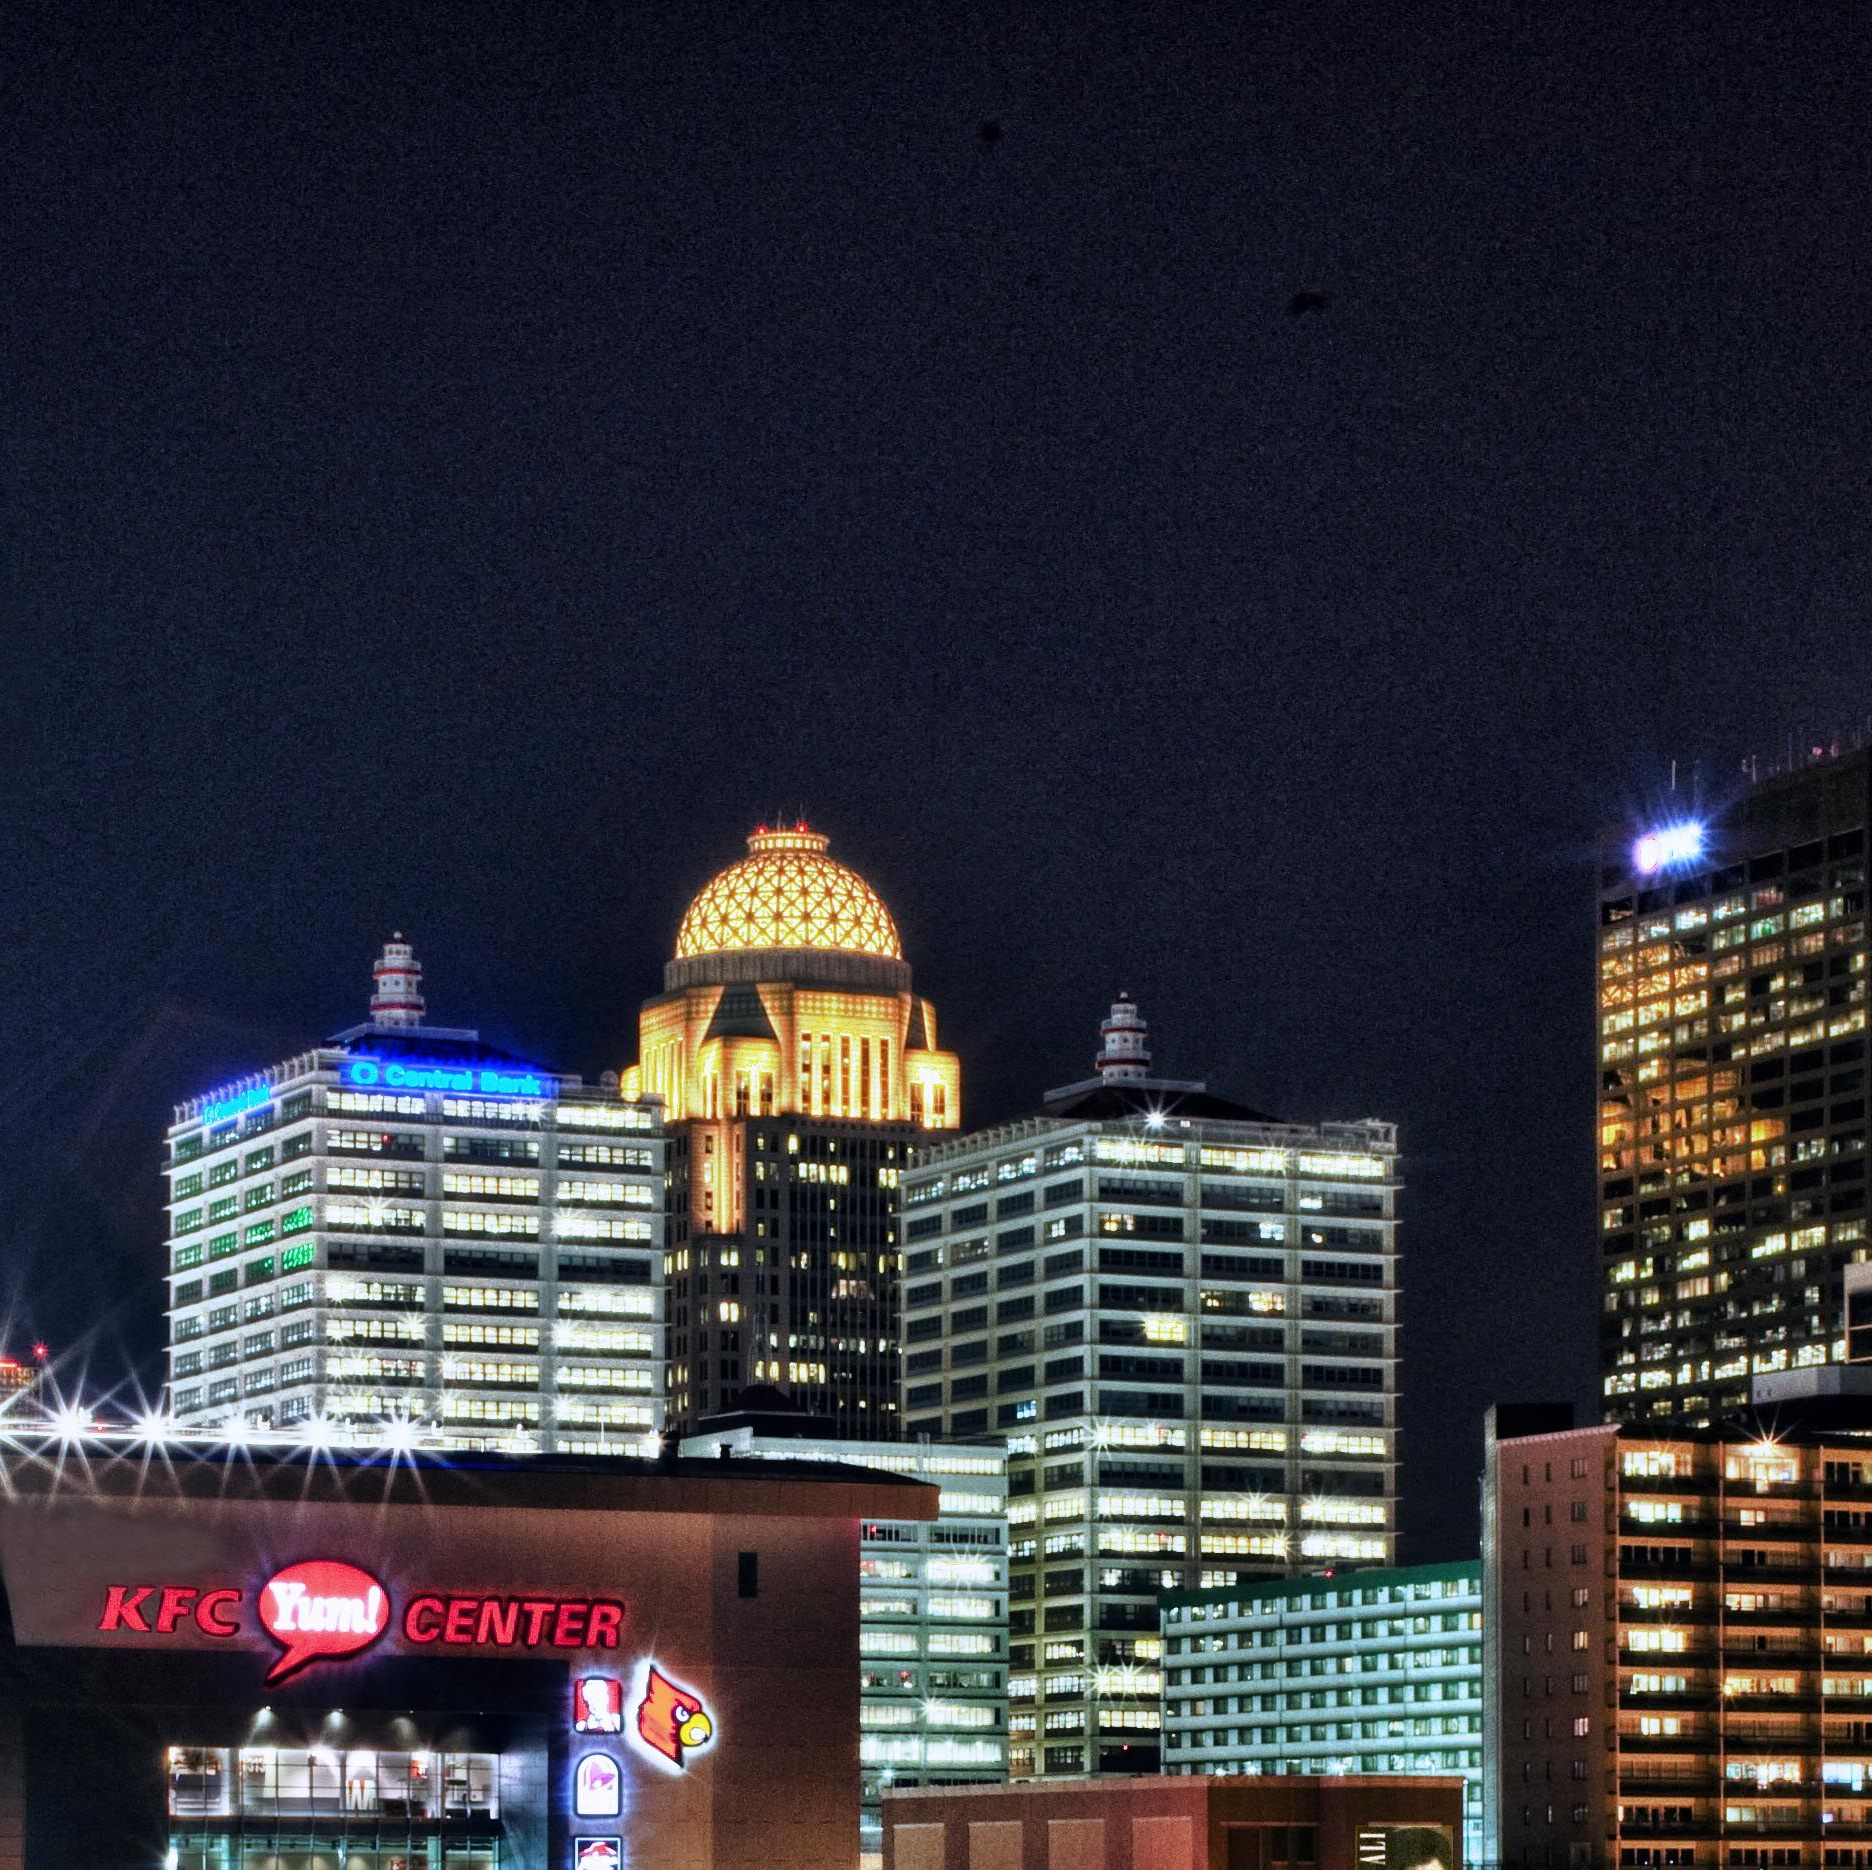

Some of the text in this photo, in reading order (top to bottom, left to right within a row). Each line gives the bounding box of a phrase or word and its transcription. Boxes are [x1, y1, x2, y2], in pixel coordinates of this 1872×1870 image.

[385, 1064, 541, 1095] Central Bank
[97, 1582, 625, 1648] KFC Yum! CENTER
[1359, 1832, 1386, 1865] ALI
